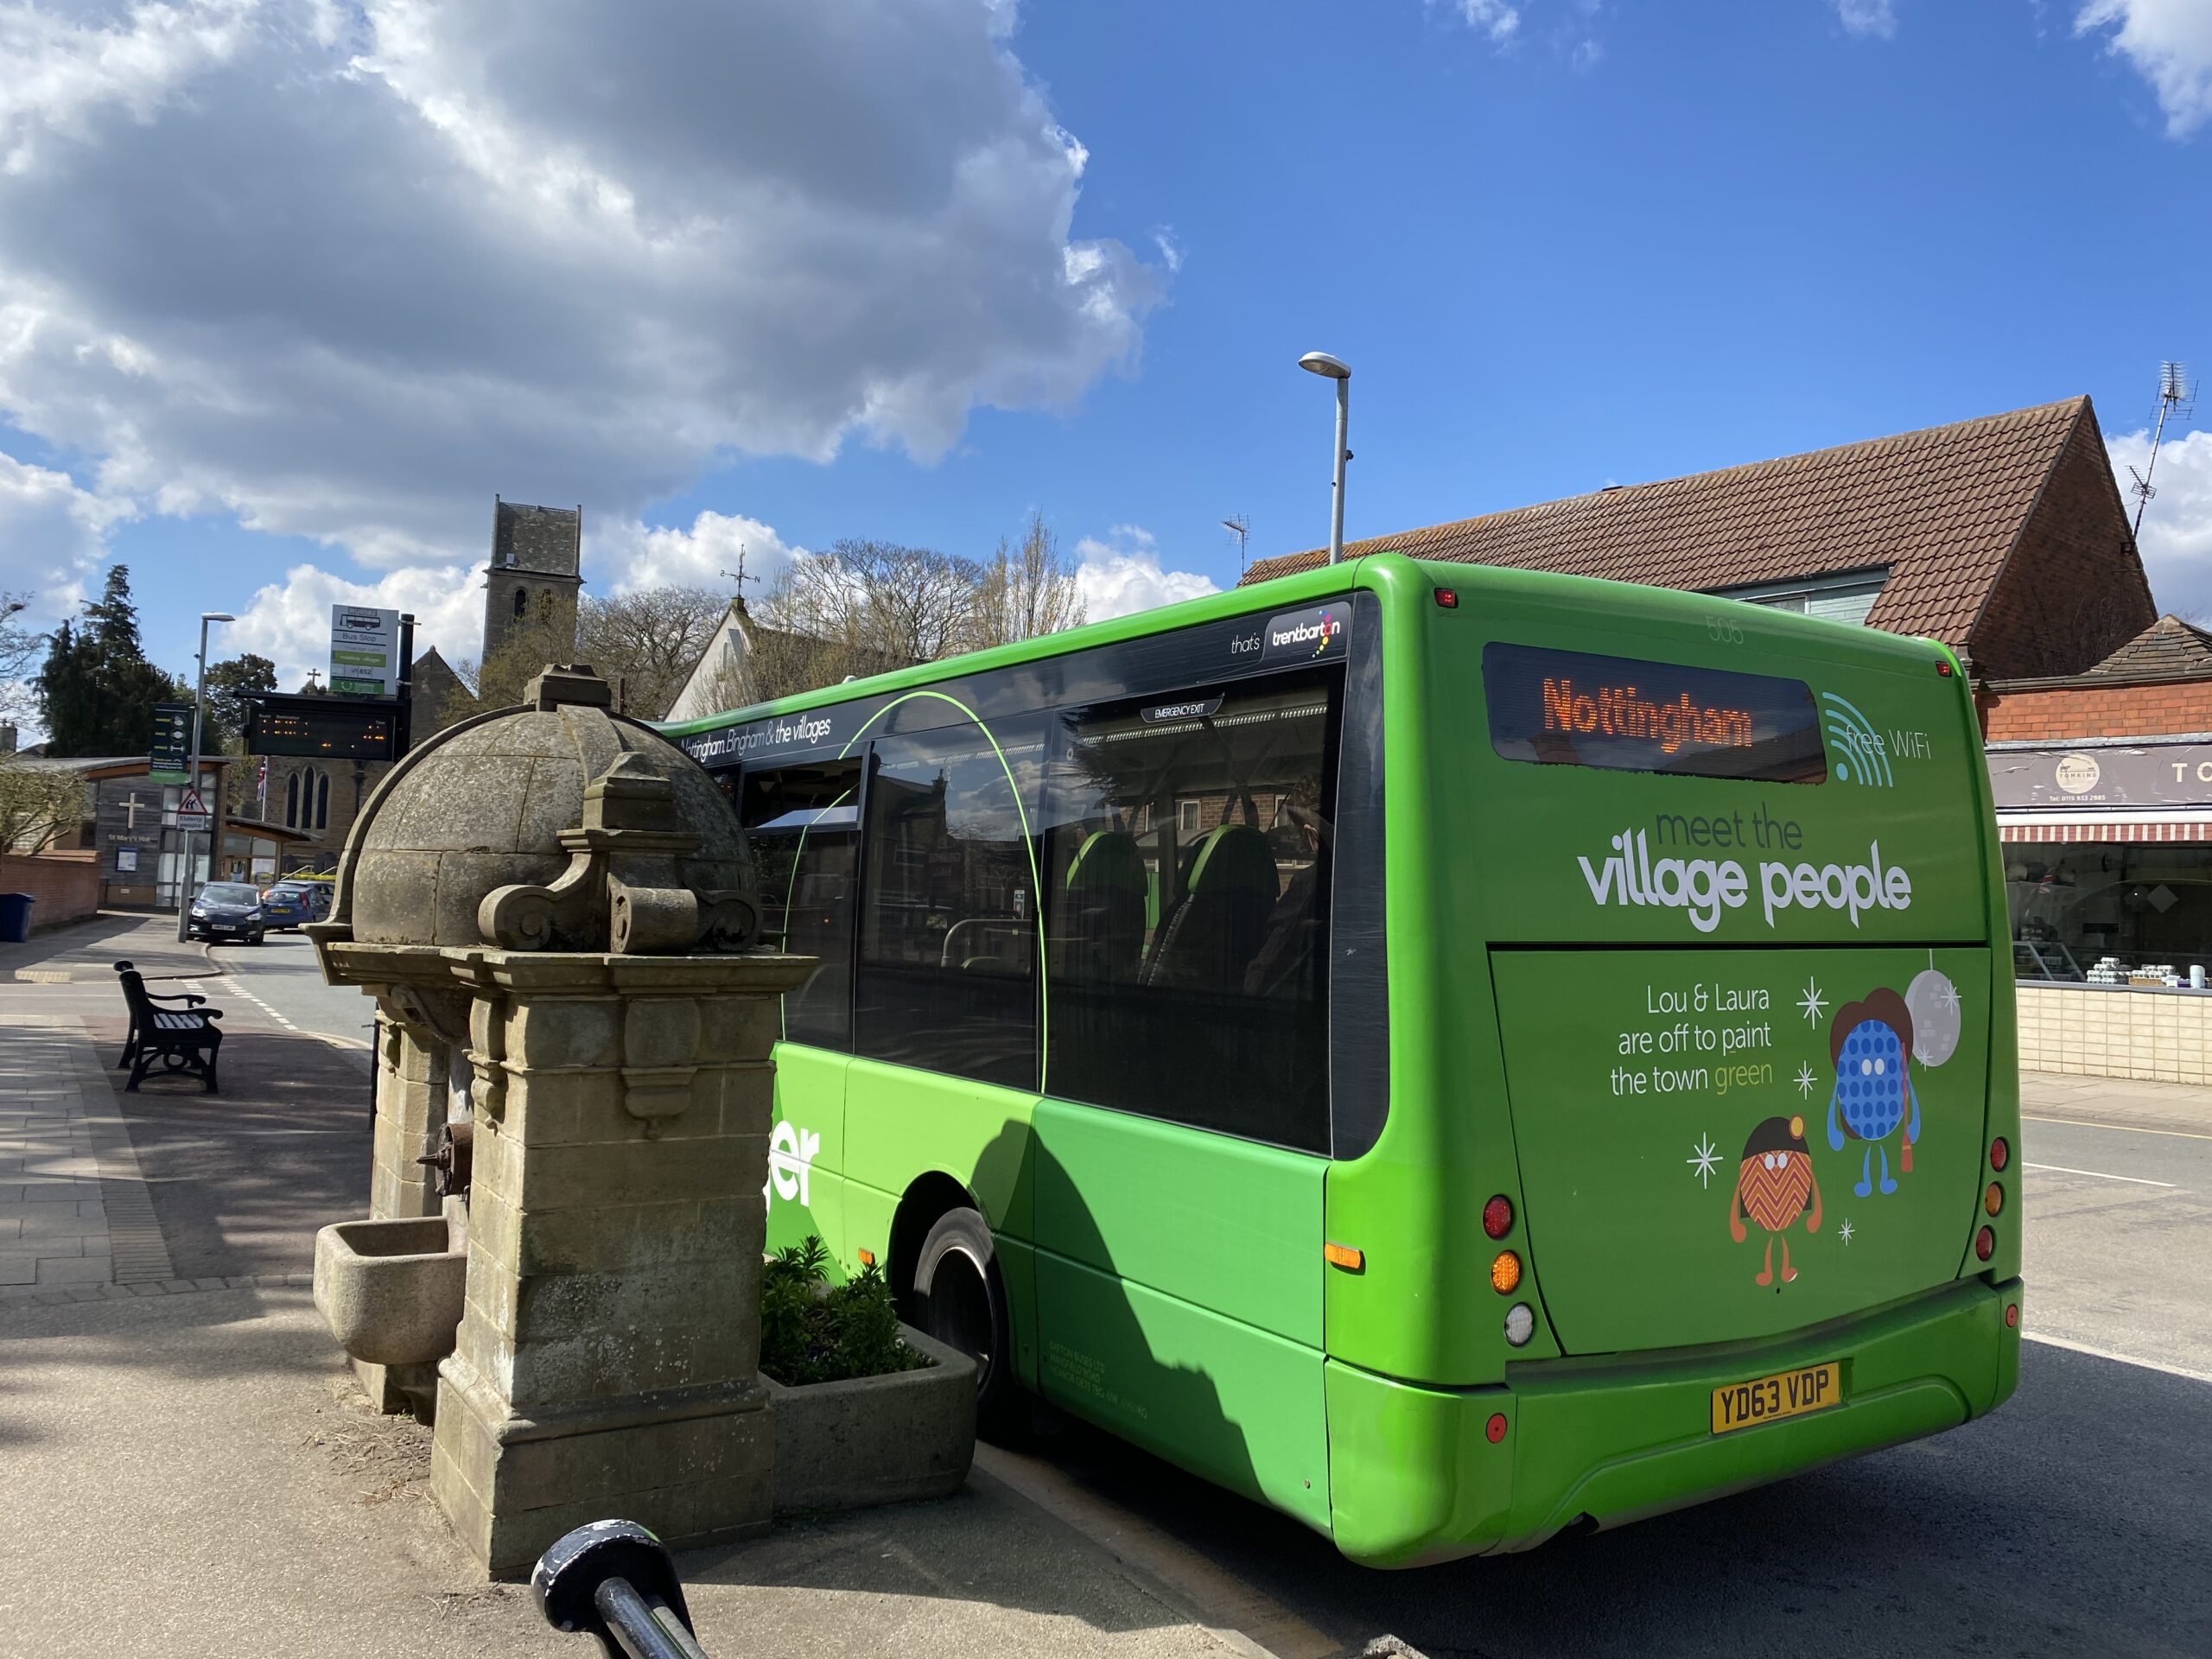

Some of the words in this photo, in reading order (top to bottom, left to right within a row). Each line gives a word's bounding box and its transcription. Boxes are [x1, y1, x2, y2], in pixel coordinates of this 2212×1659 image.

[1231, 632, 1260, 654] that's
[1273, 620, 1340, 646] trentbarton
[1706, 616, 1744, 645] 505
[1154, 706, 1190, 718] EMERGENCY
[1191, 703, 1205, 715] EXIT
[1543, 678, 1752, 753] Nottingham
[726, 727, 765, 756] Bingham
[766, 721, 773, 745] &
[775, 719, 791, 743] the
[793, 715, 831, 744] villages
[1846, 725, 1885, 755] free
[1890, 729, 1931, 760] WiFi
[1656, 810, 1745, 848] meet
[1753, 802, 1802, 850] the
[1577, 827, 1748, 932] village
[1759, 839, 1911, 929] people
[1648, 985, 1688, 1014] Lou
[1694, 983, 1708, 1012] &
[1716, 983, 1770, 1011] Laura
[1618, 1032, 1652, 1054] are
[1659, 1023, 1689, 1052] off
[1694, 1025, 1716, 1050] to
[1722, 1020, 1771, 1057] paint
[1611, 1066, 1647, 1096] the
[1653, 1066, 1708, 1093] town
[1715, 1064, 1772, 1095] green
[1720, 1380, 1780, 1424] YD63
[1787, 1370, 1828, 1408] VDP
